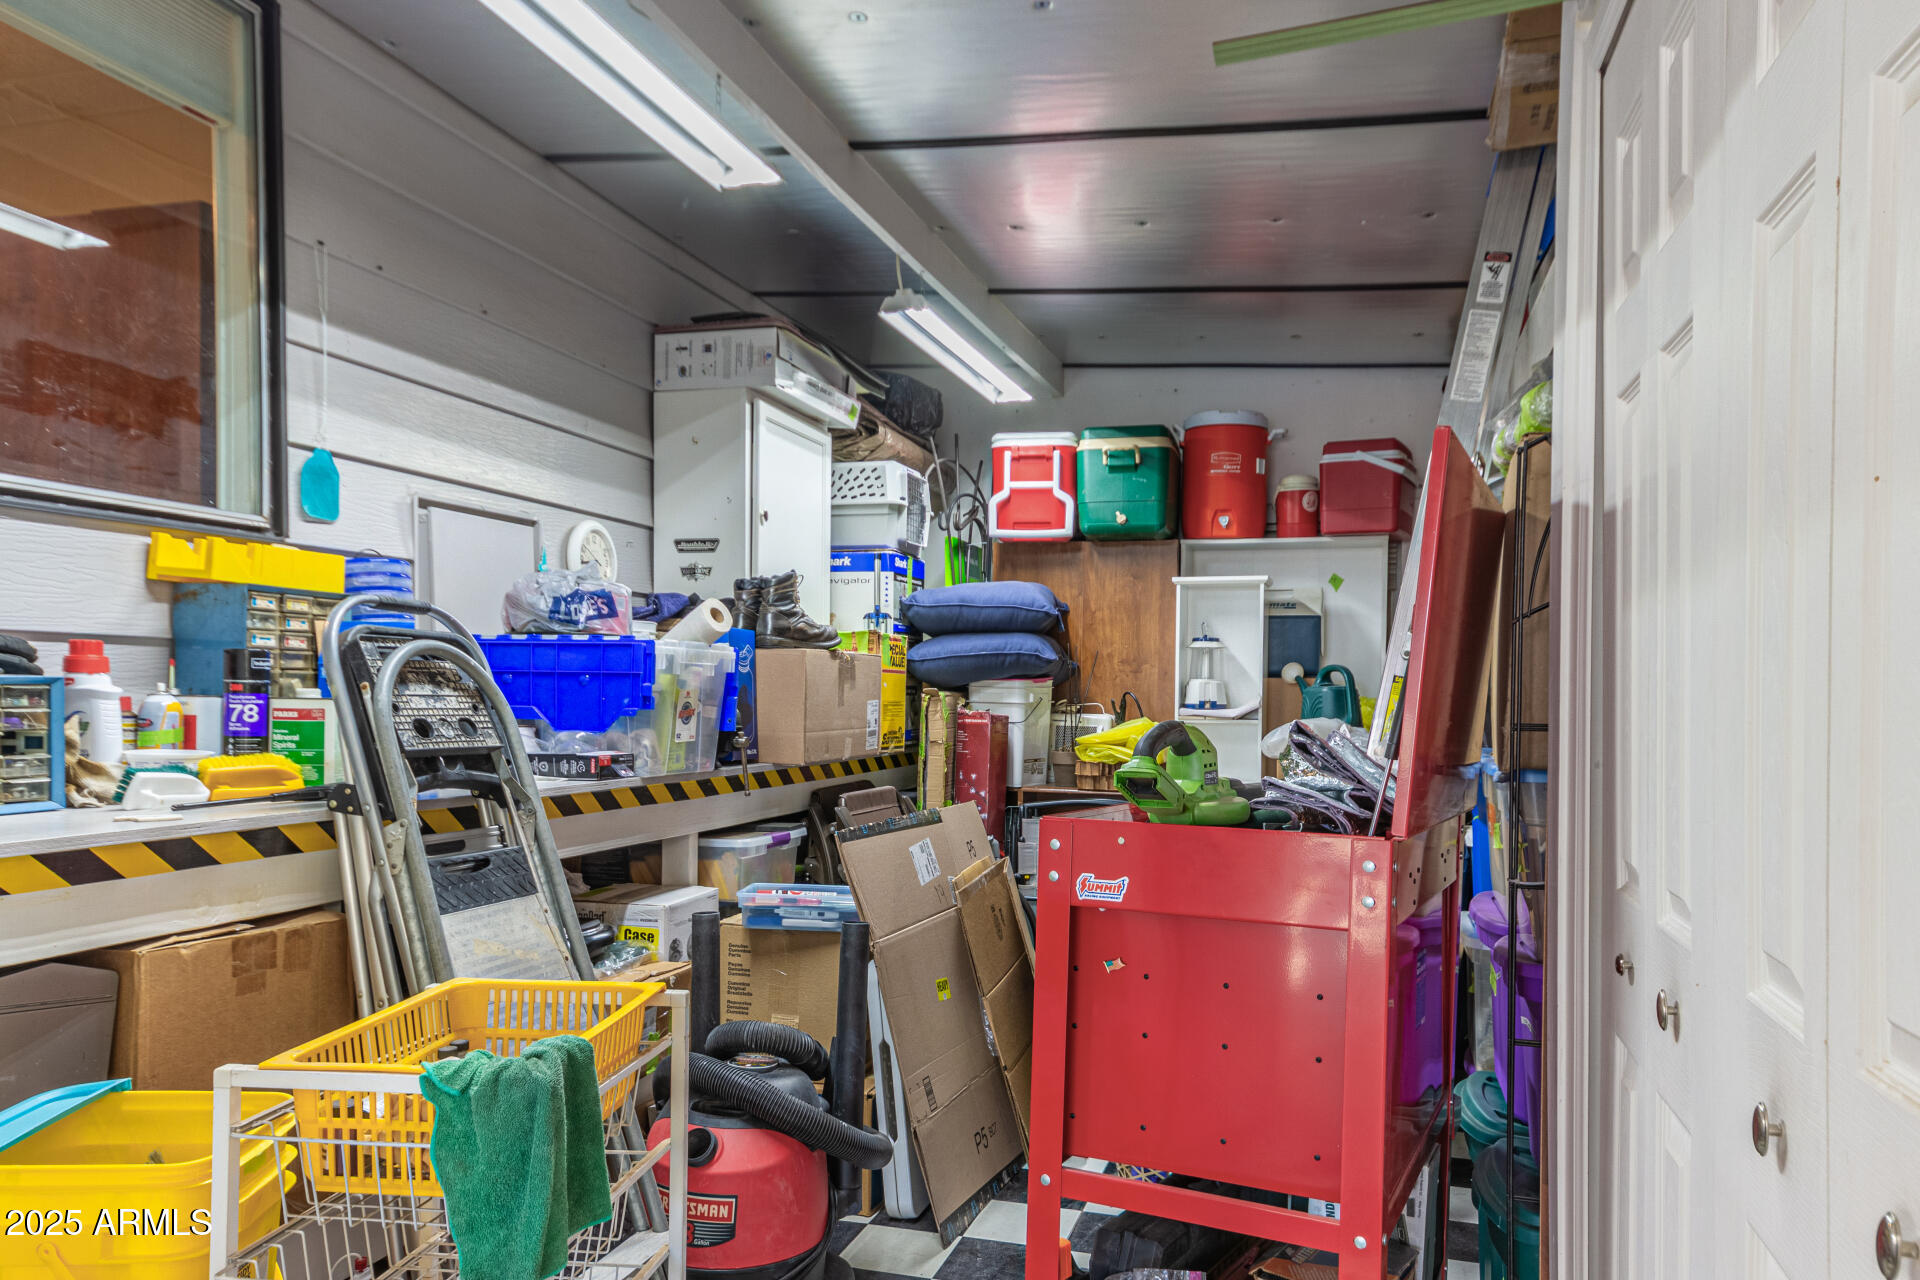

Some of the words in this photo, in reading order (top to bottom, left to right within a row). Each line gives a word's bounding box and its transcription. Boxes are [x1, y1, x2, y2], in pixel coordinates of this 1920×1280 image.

[830, 577, 870, 585] vigator
[228, 704, 260, 723] 78
[624, 928, 655, 943] Case
[974, 1126, 989, 1154] P5
